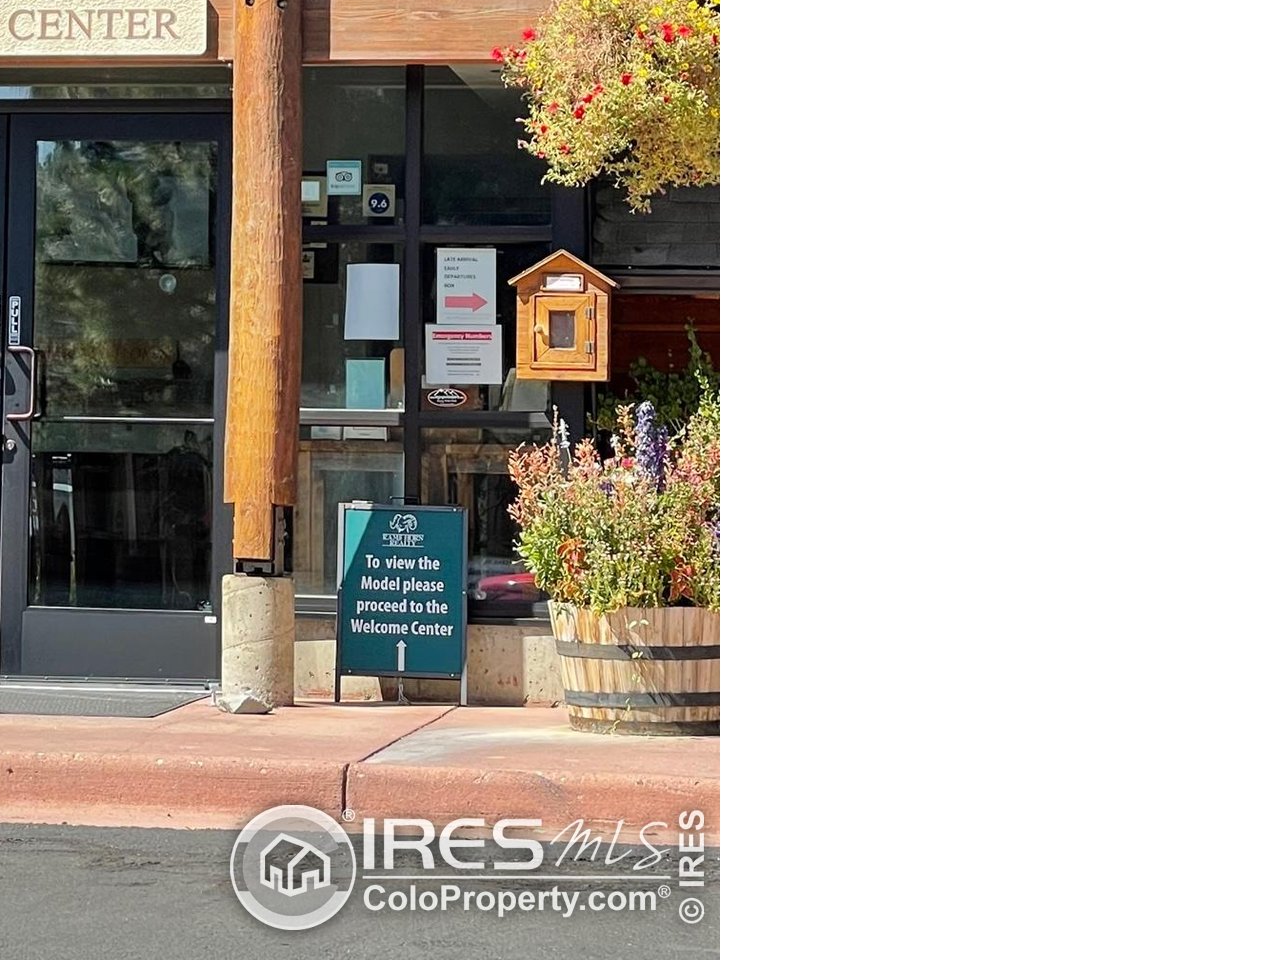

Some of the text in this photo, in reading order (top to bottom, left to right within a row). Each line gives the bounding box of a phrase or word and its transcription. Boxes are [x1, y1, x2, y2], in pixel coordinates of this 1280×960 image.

[8, 8, 181, 41] CENTER
[370, 199, 388, 209] 9.6
[10, 300, 20, 334] PULL
[365, 554, 440, 570] To view the
[361, 575, 444, 595] Model please
[356, 598, 449, 615] proceed to the
[350, 618, 454, 636] Welcome Center
